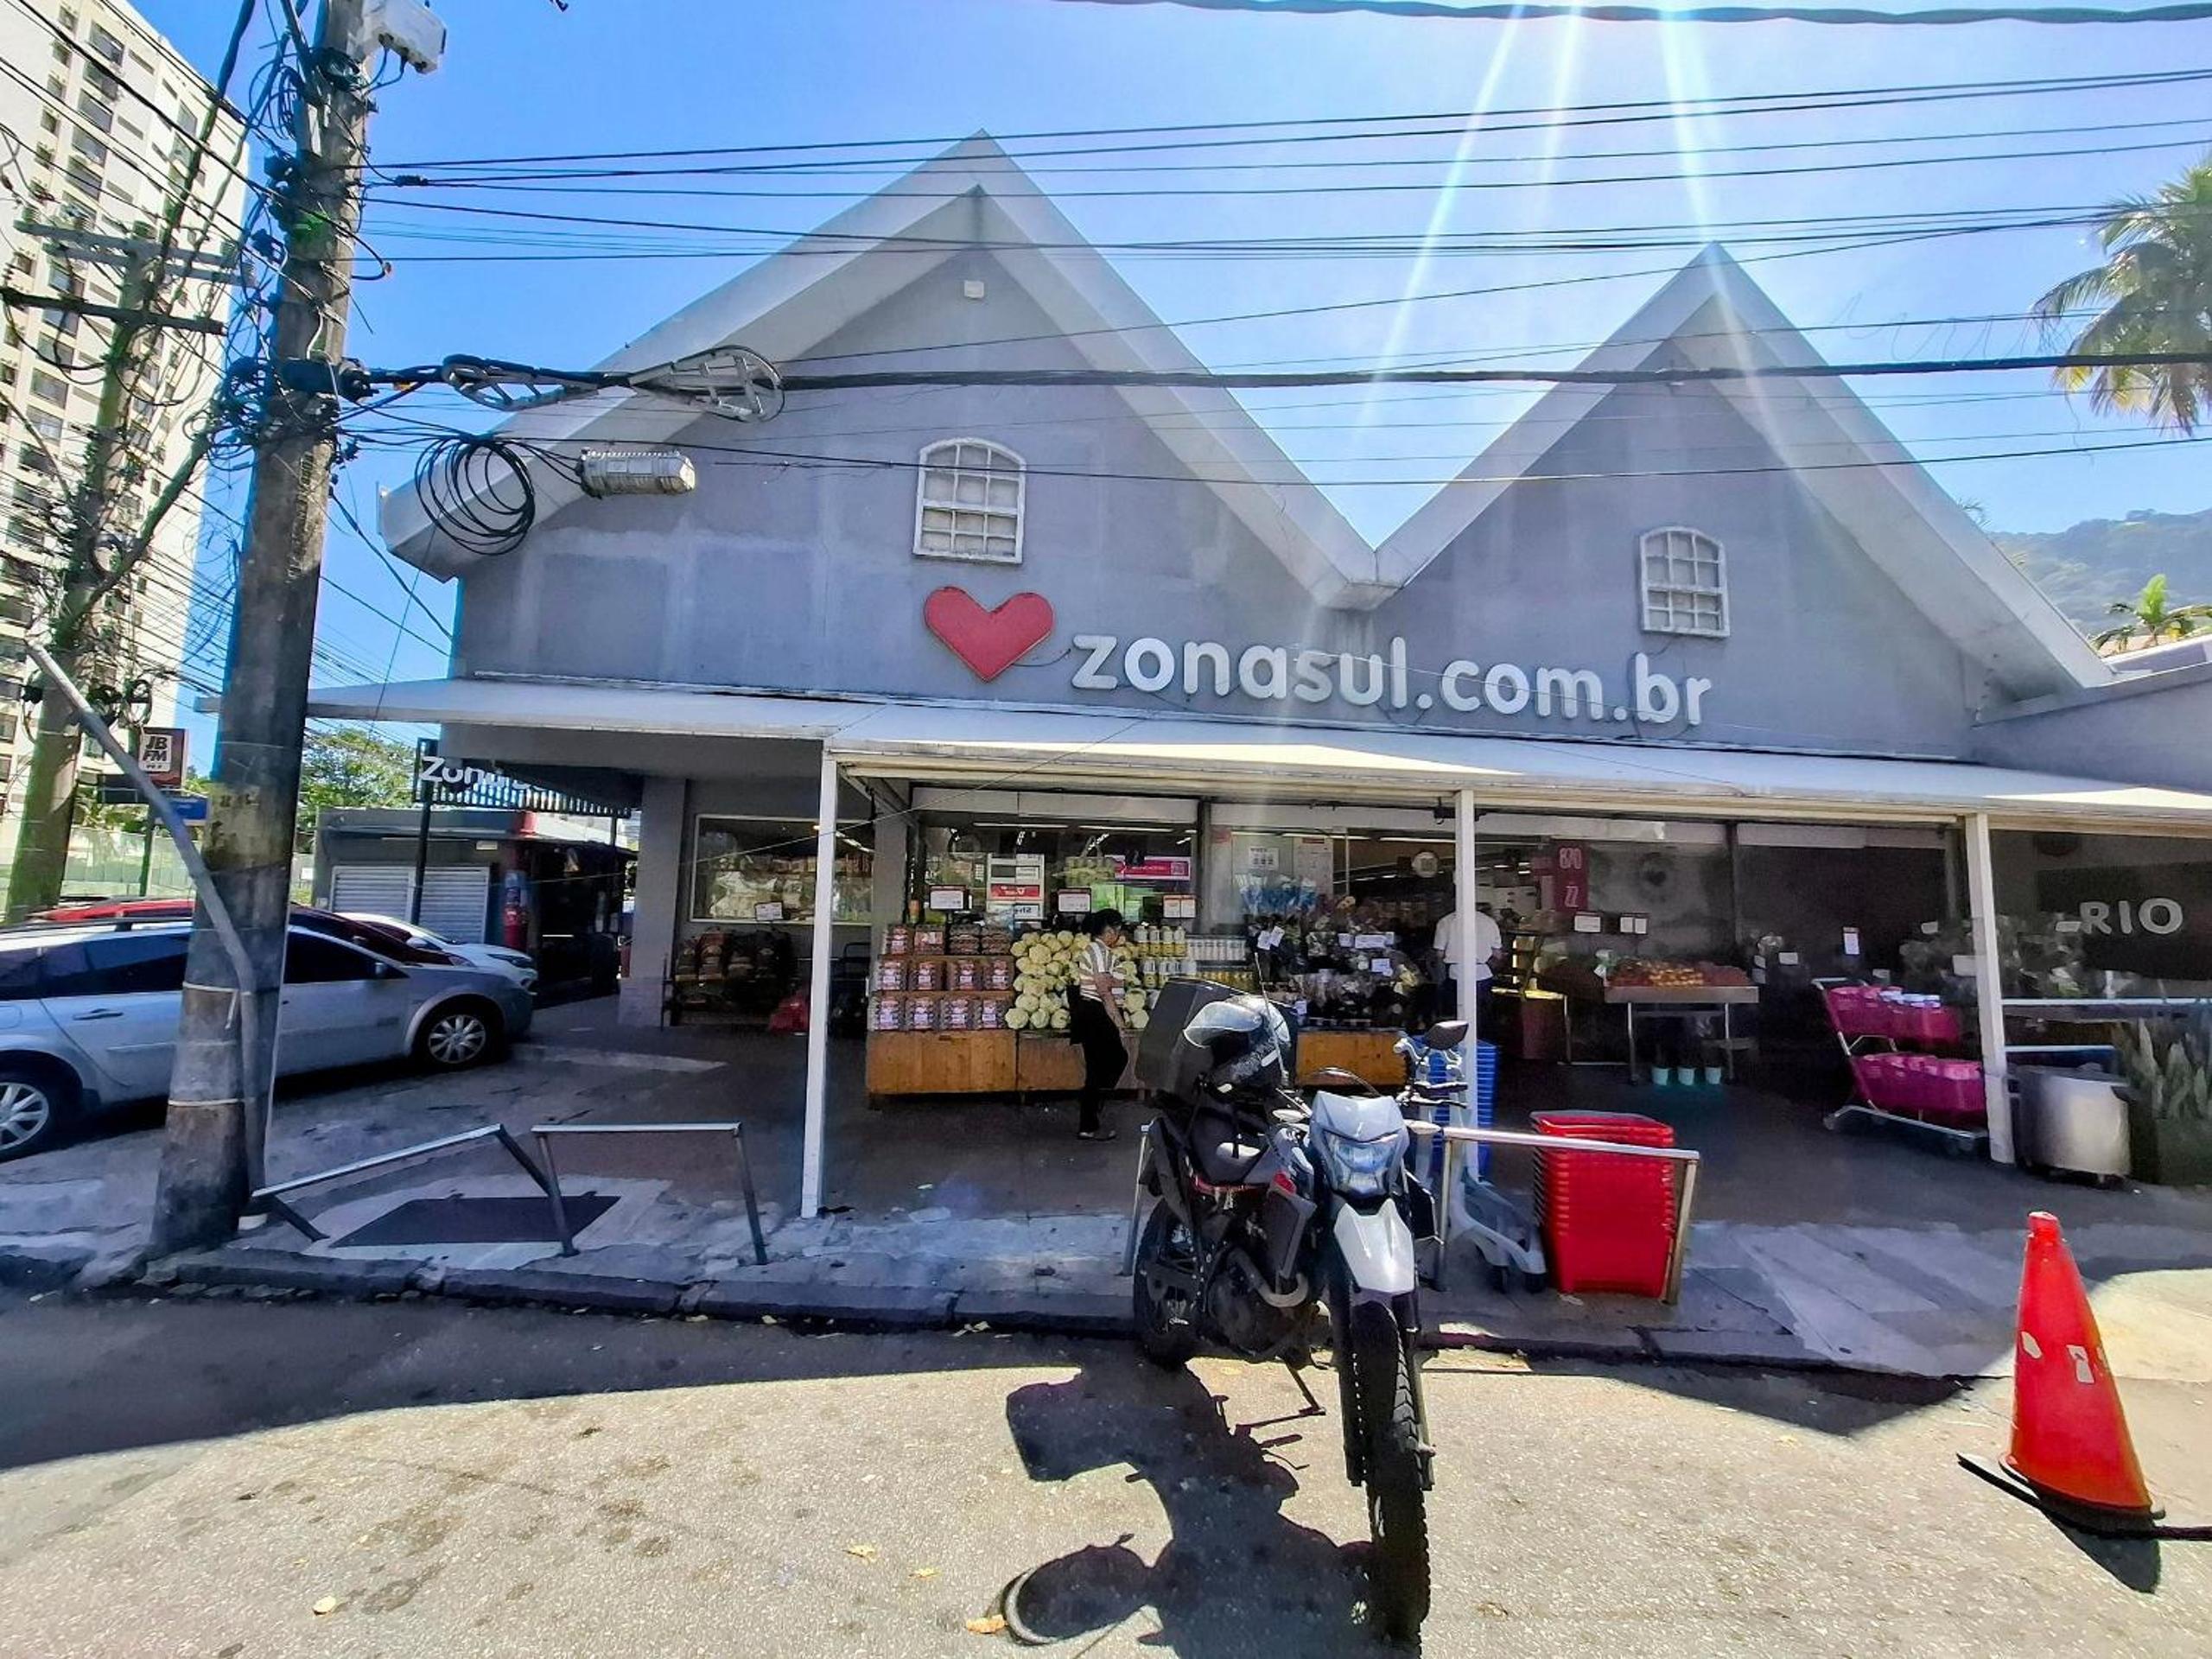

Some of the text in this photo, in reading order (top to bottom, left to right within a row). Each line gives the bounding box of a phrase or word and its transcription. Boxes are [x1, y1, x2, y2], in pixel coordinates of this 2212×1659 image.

[1071, 634, 1713, 725] zonasul.com.br
[143, 750, 168, 761] FM
[145, 735, 168, 750] JB
[2079, 897, 2183, 935] RIO
